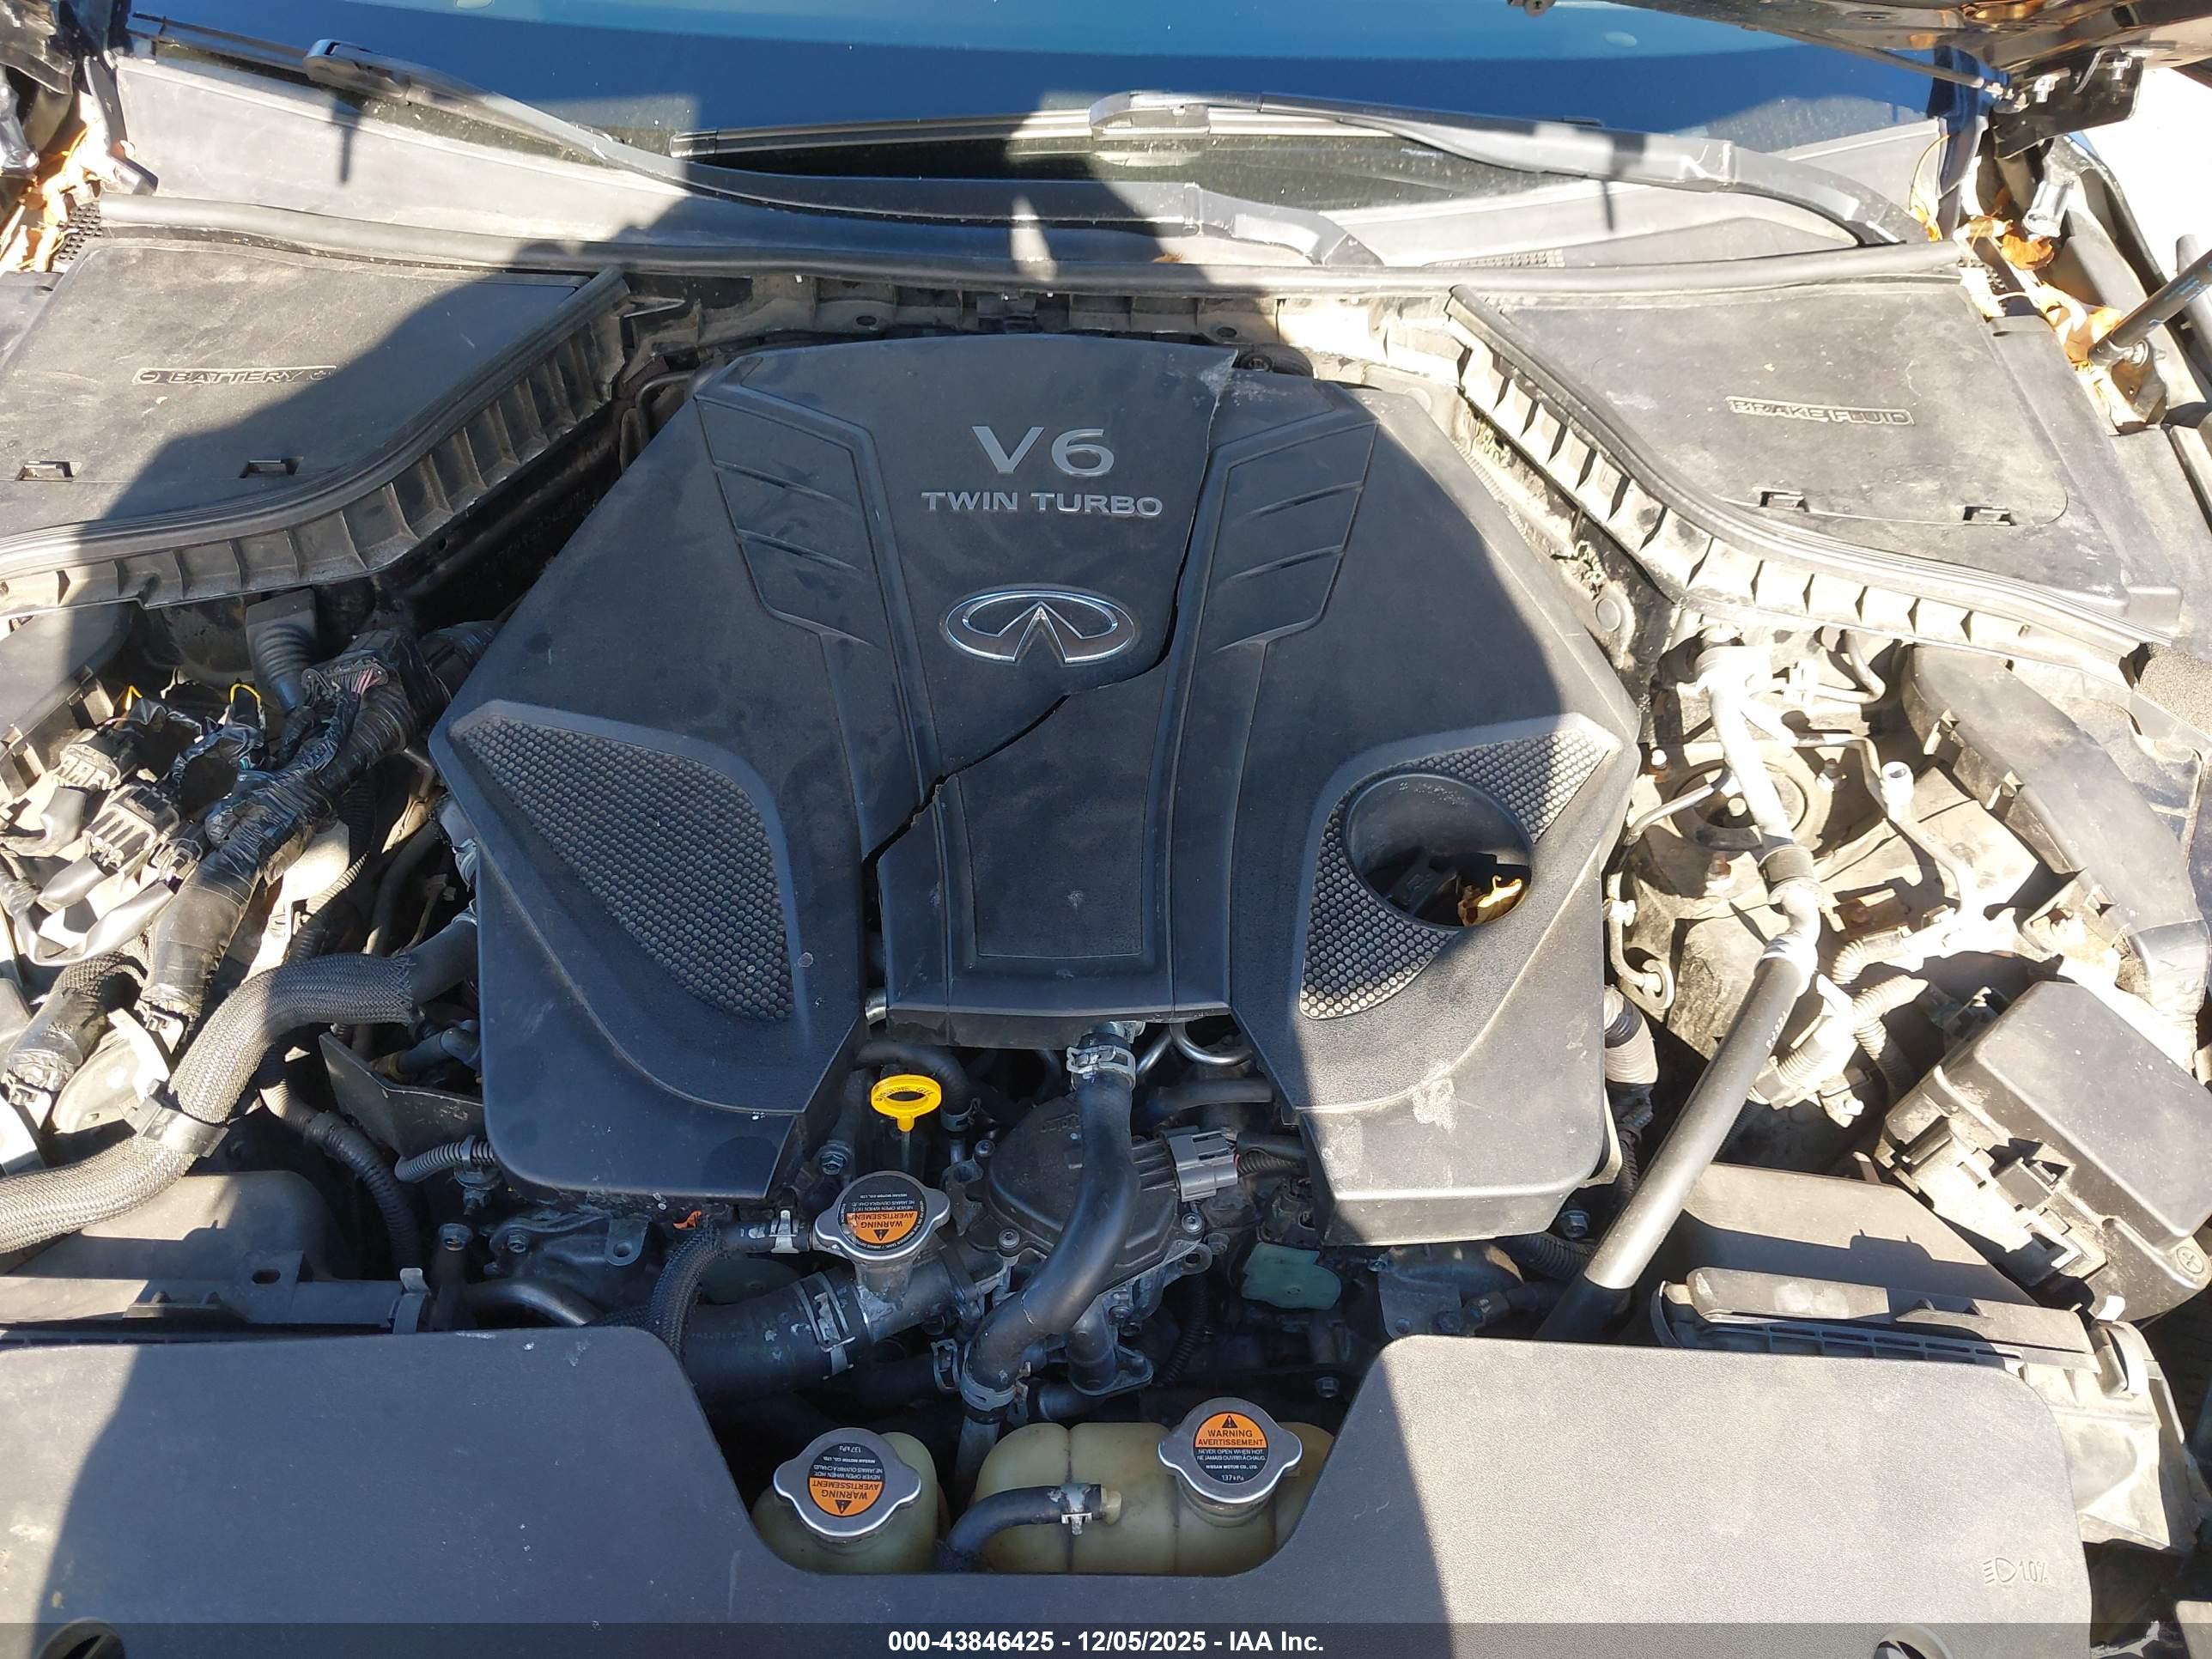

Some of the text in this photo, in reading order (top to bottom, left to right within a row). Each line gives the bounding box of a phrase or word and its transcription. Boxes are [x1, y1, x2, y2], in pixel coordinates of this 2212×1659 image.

[169, 370, 302, 384] BATTERY
[1730, 400, 1911, 425] BRAKE FLUID
[972, 426, 1115, 477] V6
[921, 491, 1164, 516] TWIN TURBO
[812, 1481, 879, 1491] AVERTISSEMENT
[821, 1490, 868, 1499] WARNING
